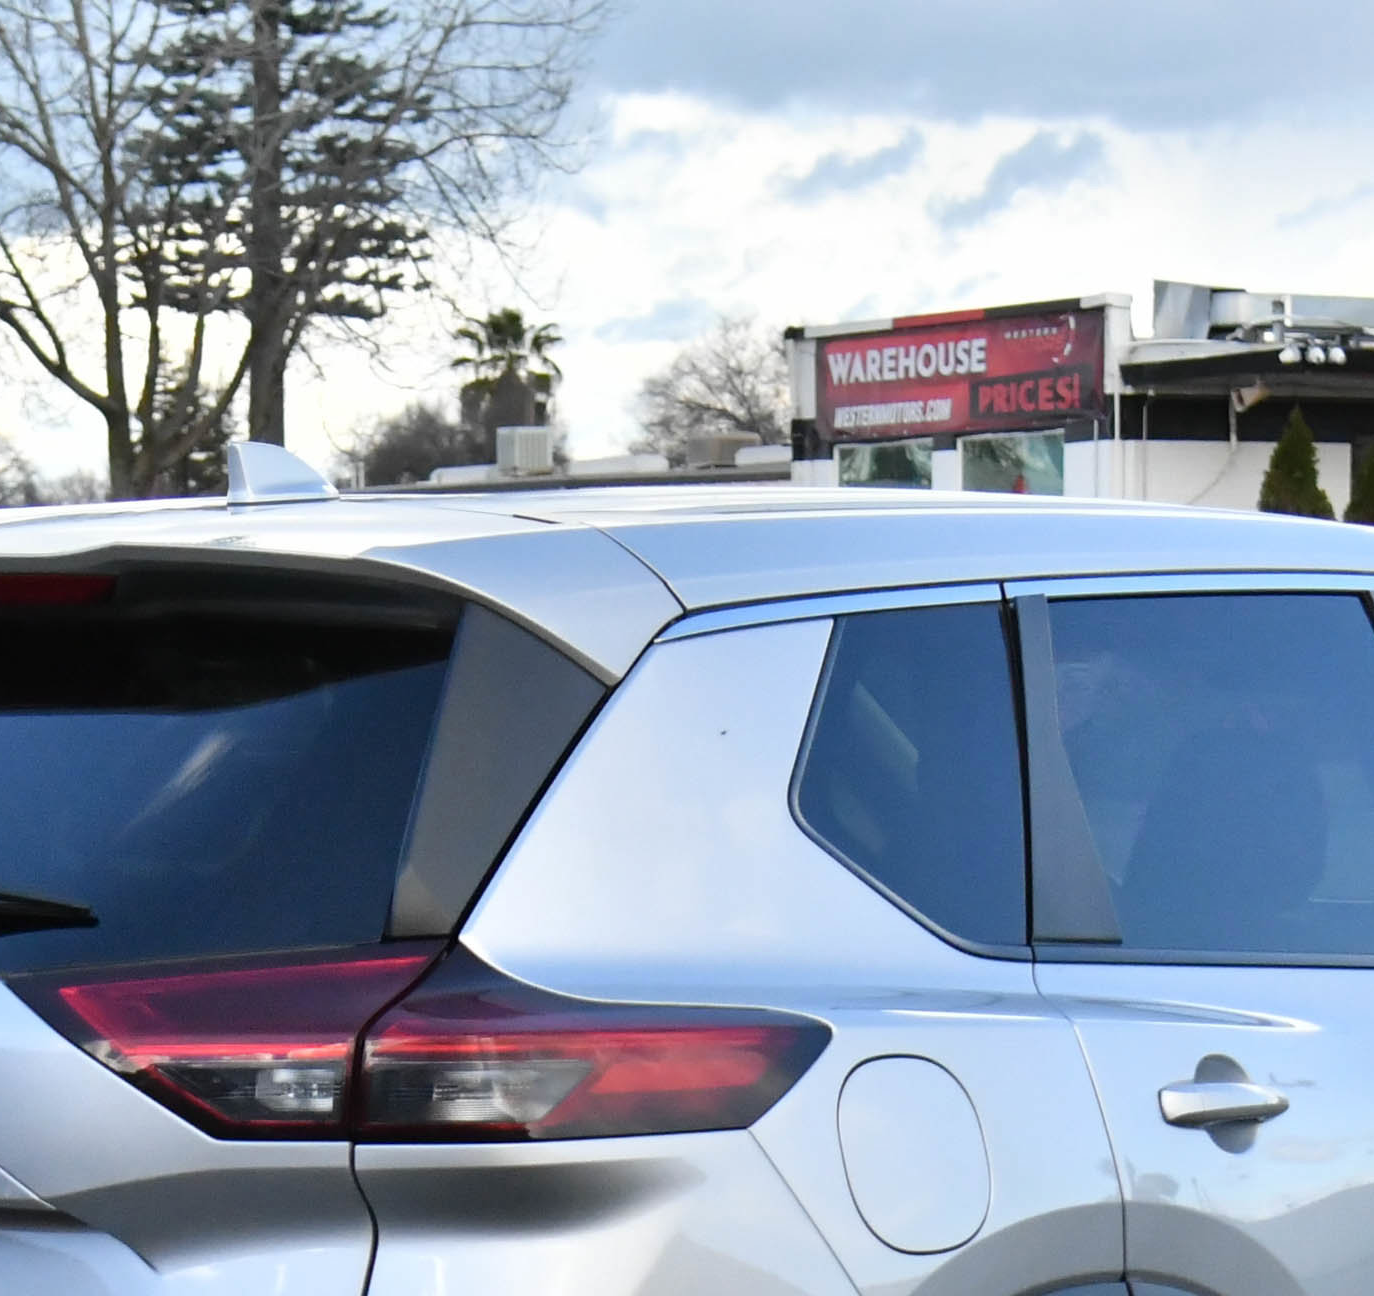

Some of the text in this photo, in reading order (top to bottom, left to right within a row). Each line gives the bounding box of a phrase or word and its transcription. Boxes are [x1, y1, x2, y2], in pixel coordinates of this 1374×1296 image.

[828, 337, 987, 386] WAREHOUSE
[833, 398, 952, 429] WESTERNMOTORS.COM
[978, 372, 1082, 414] PRICES!
